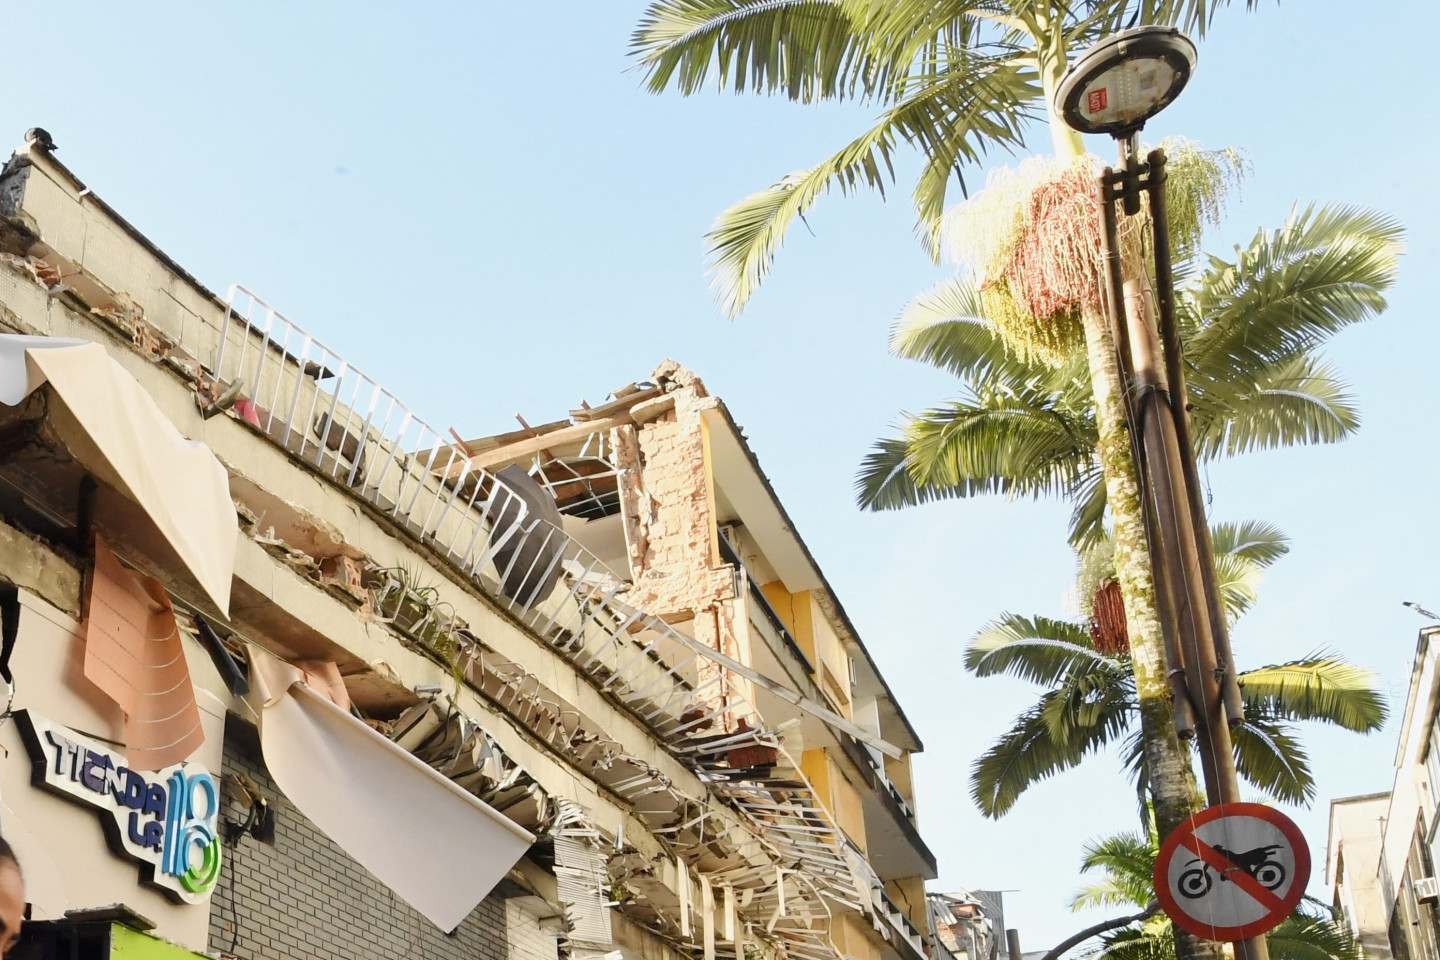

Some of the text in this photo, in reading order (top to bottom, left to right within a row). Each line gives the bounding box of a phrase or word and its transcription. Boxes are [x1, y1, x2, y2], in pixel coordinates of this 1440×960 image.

[45, 730, 167, 821] TIENDA
[128, 811, 164, 853] LA
[162, 769, 222, 893] 18
